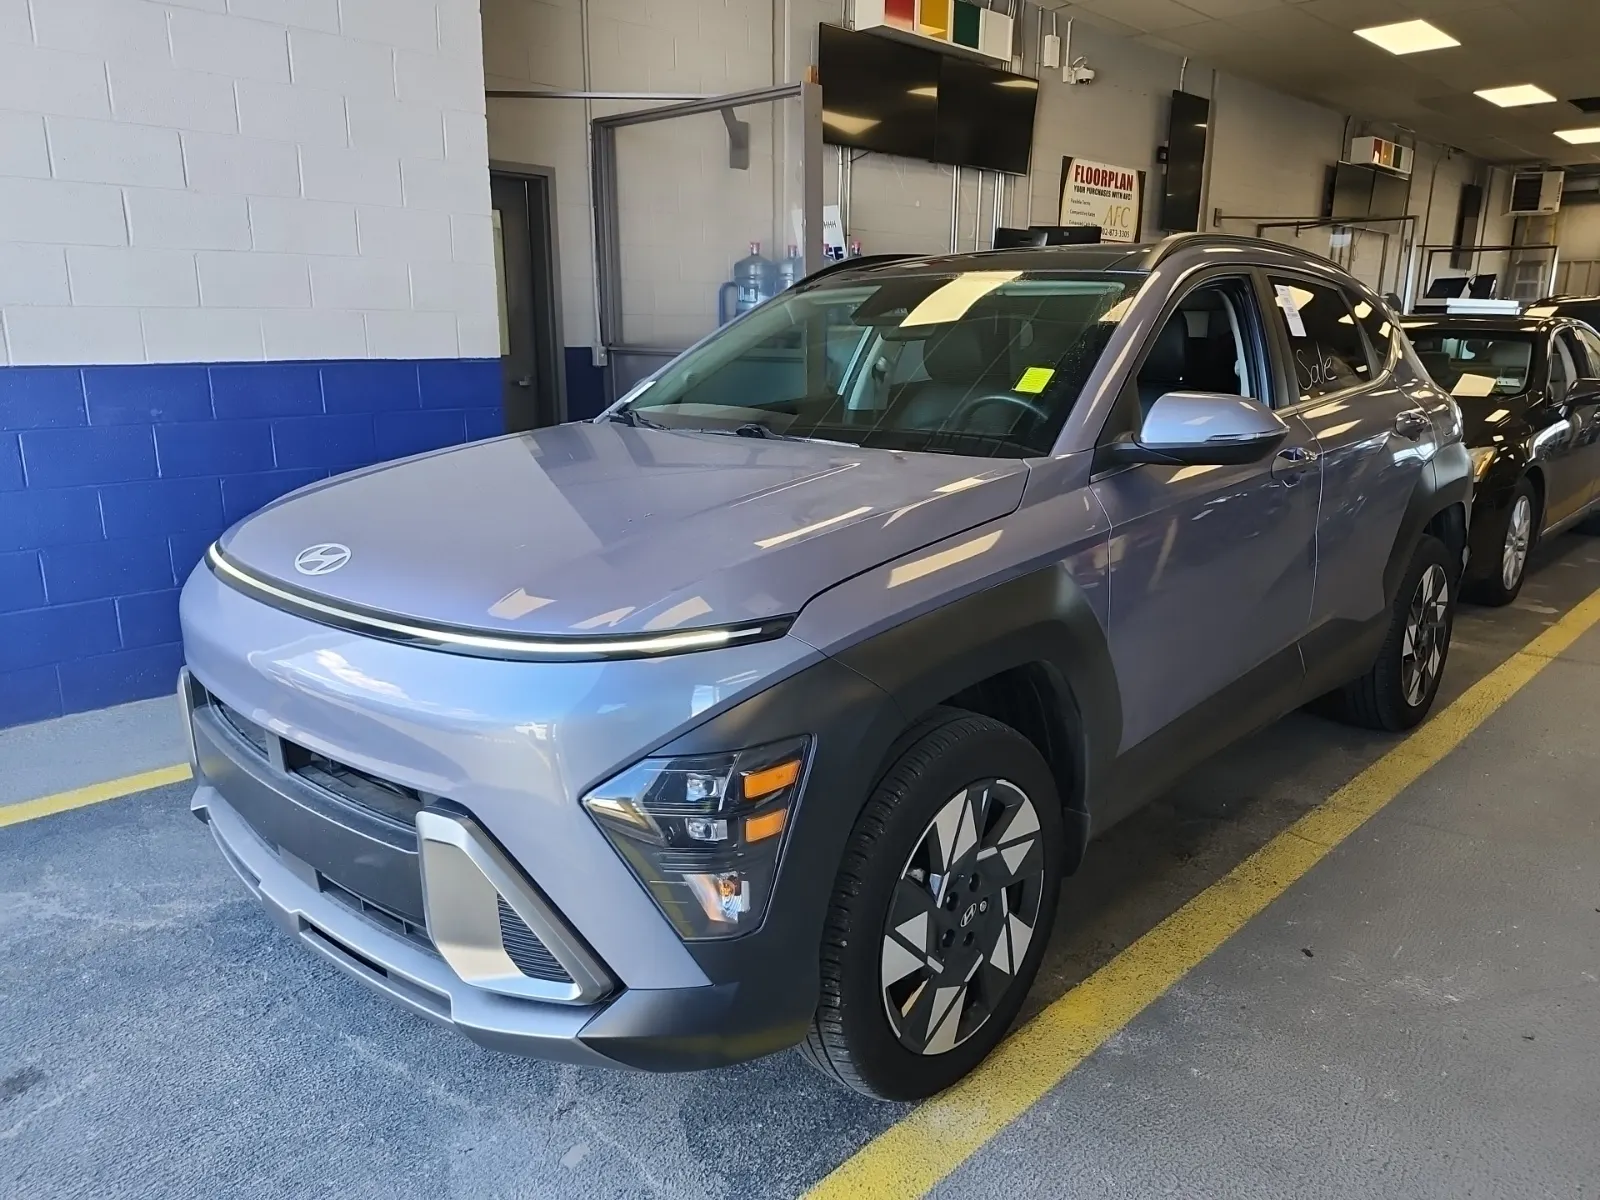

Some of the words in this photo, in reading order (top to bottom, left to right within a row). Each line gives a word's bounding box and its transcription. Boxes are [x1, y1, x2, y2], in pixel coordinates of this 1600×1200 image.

[1074, 164, 1134, 192] FLOORPLAN
[1074, 185, 1085, 193] YOUR
[1086, 187, 1111, 198] PURCHASES
[1111, 191, 1123, 200] WITH
[1103, 204, 1131, 228] AFC
[1296, 341, 1338, 391] Sale
